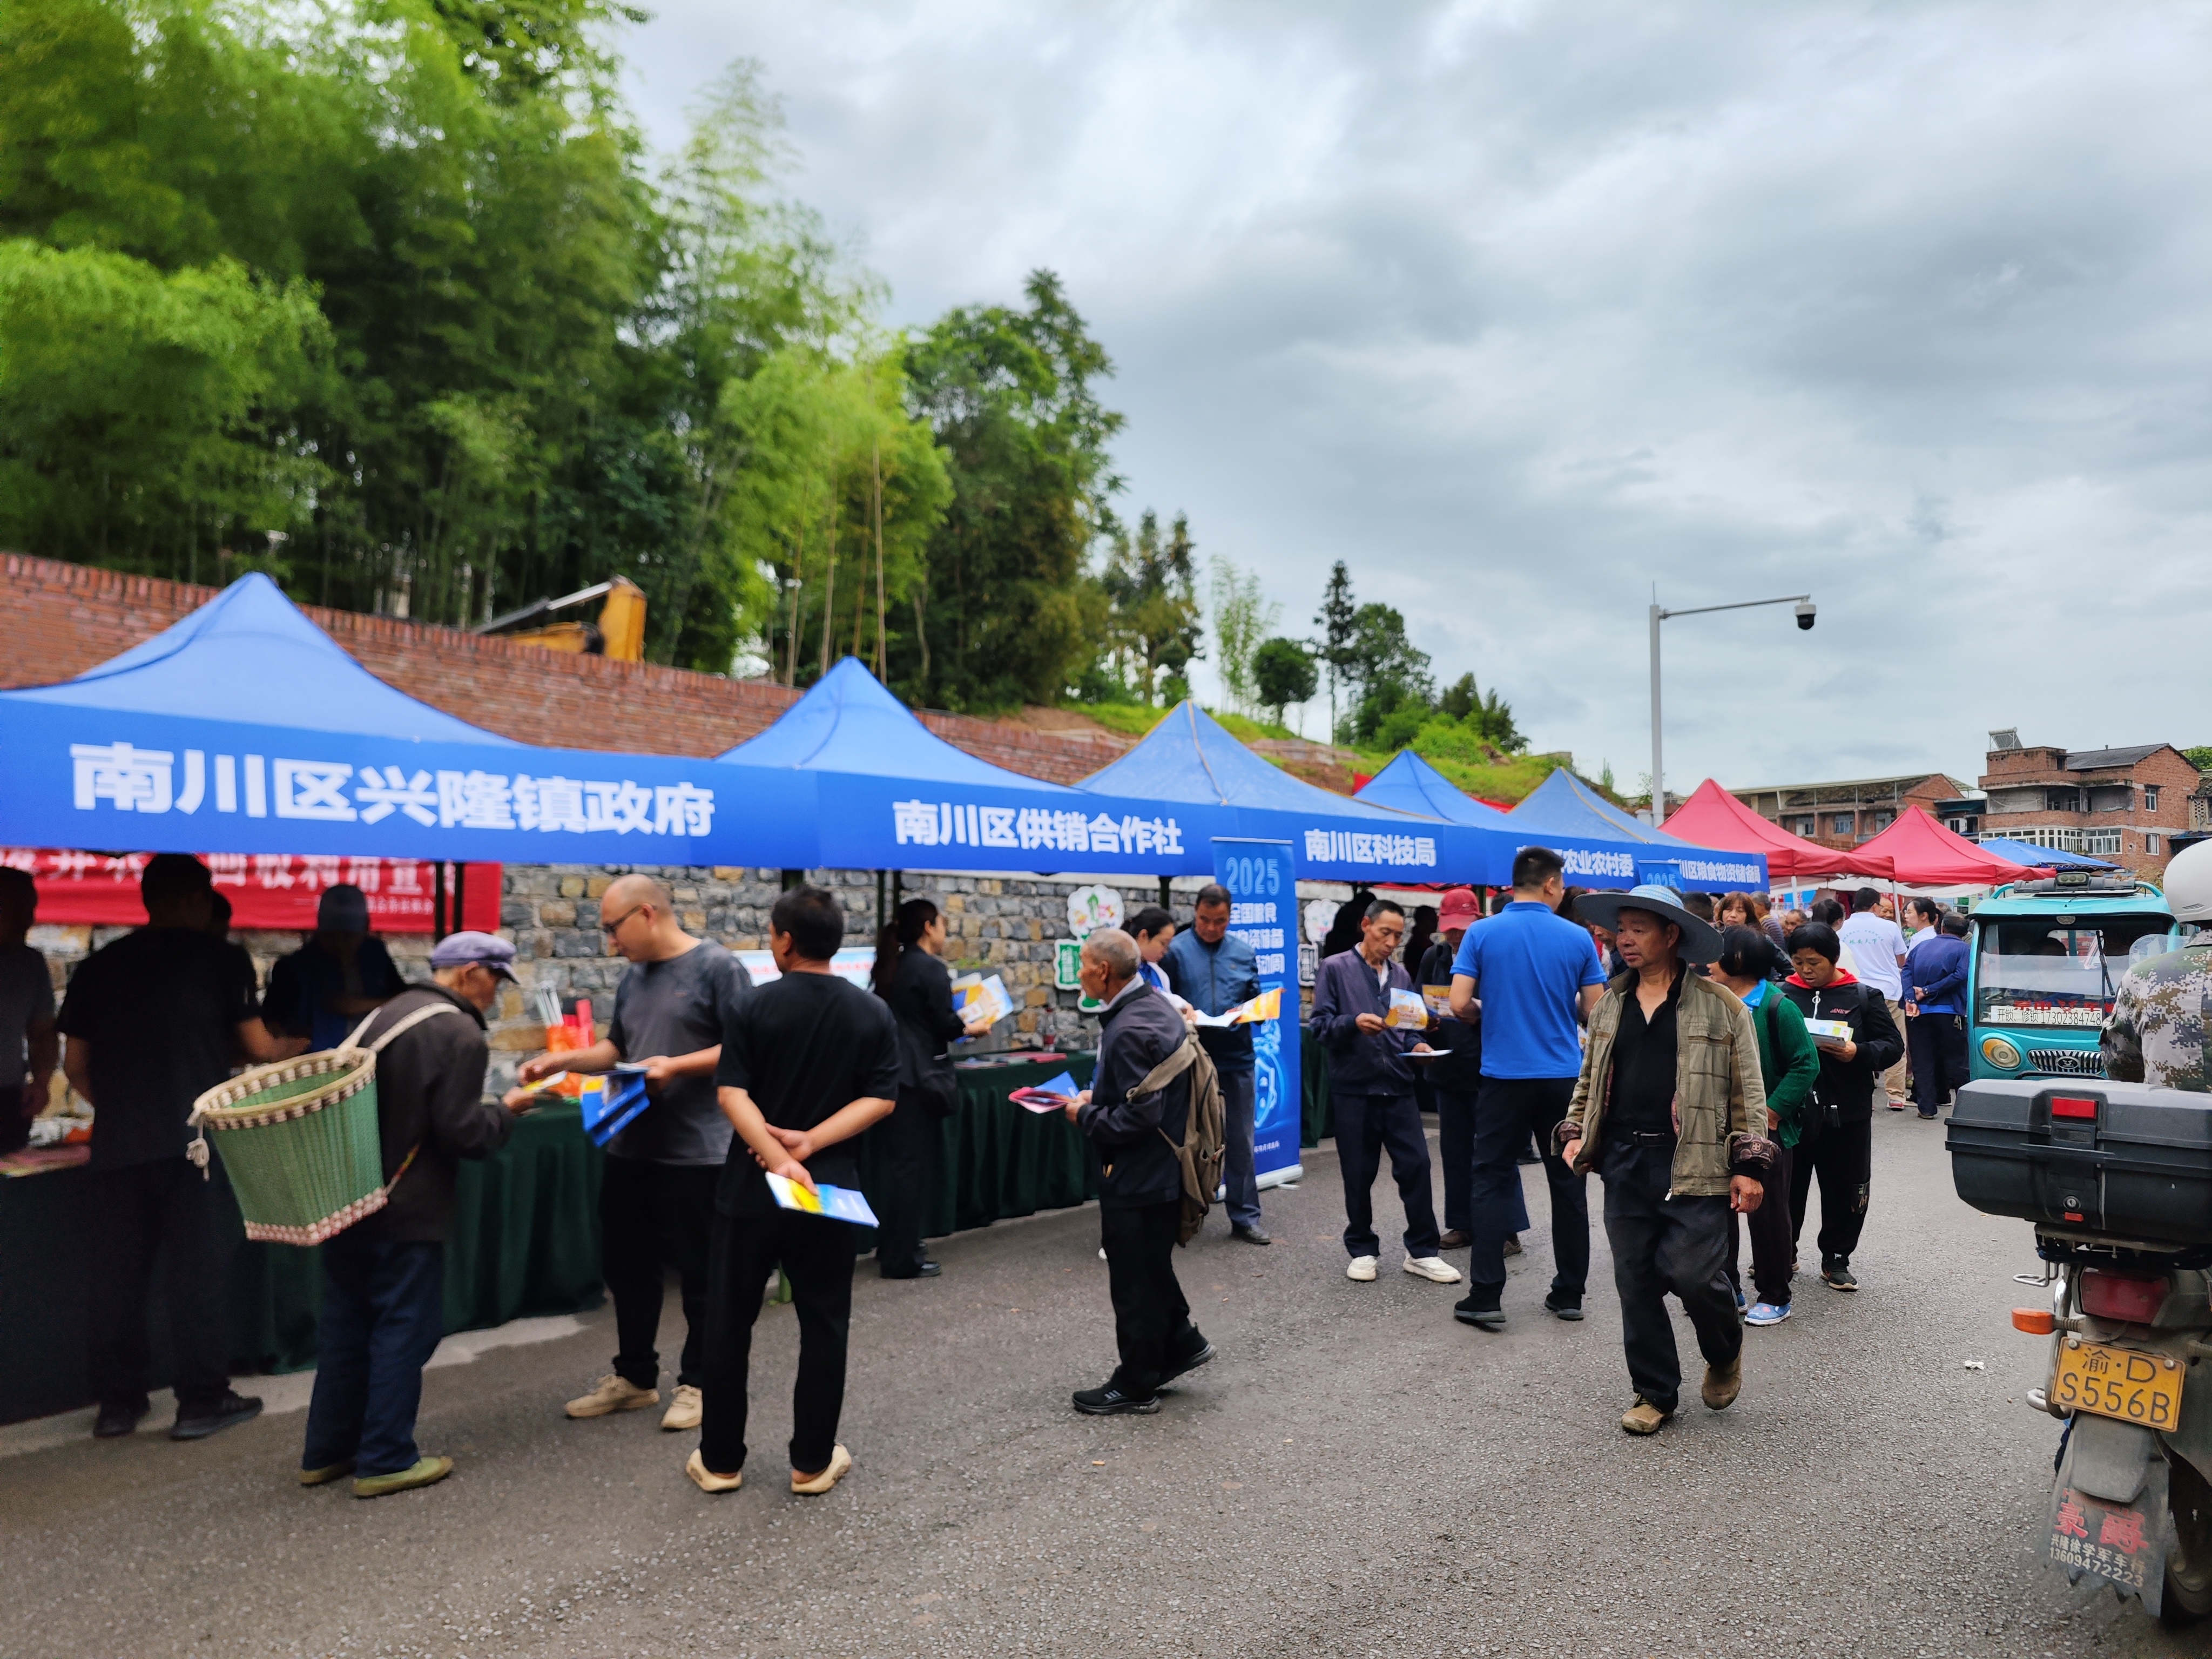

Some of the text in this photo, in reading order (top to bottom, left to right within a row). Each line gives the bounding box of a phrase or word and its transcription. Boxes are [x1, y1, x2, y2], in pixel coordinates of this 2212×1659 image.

[70, 742, 715, 837] 南川区兴隆镇政府
[892, 799, 1185, 855] 南川区供销合作社
[1304, 828, 1438, 867] 南川区科技局
[1225, 857, 1280, 896] 2025
[1669, 858, 1762, 884] 川区粮食物资储备局
[2041, 1011, 2101, 1026] 17302384748
[2060, 1372, 2170, 1423] S556B
[2049, 1547, 2144, 1588] 13609472223
